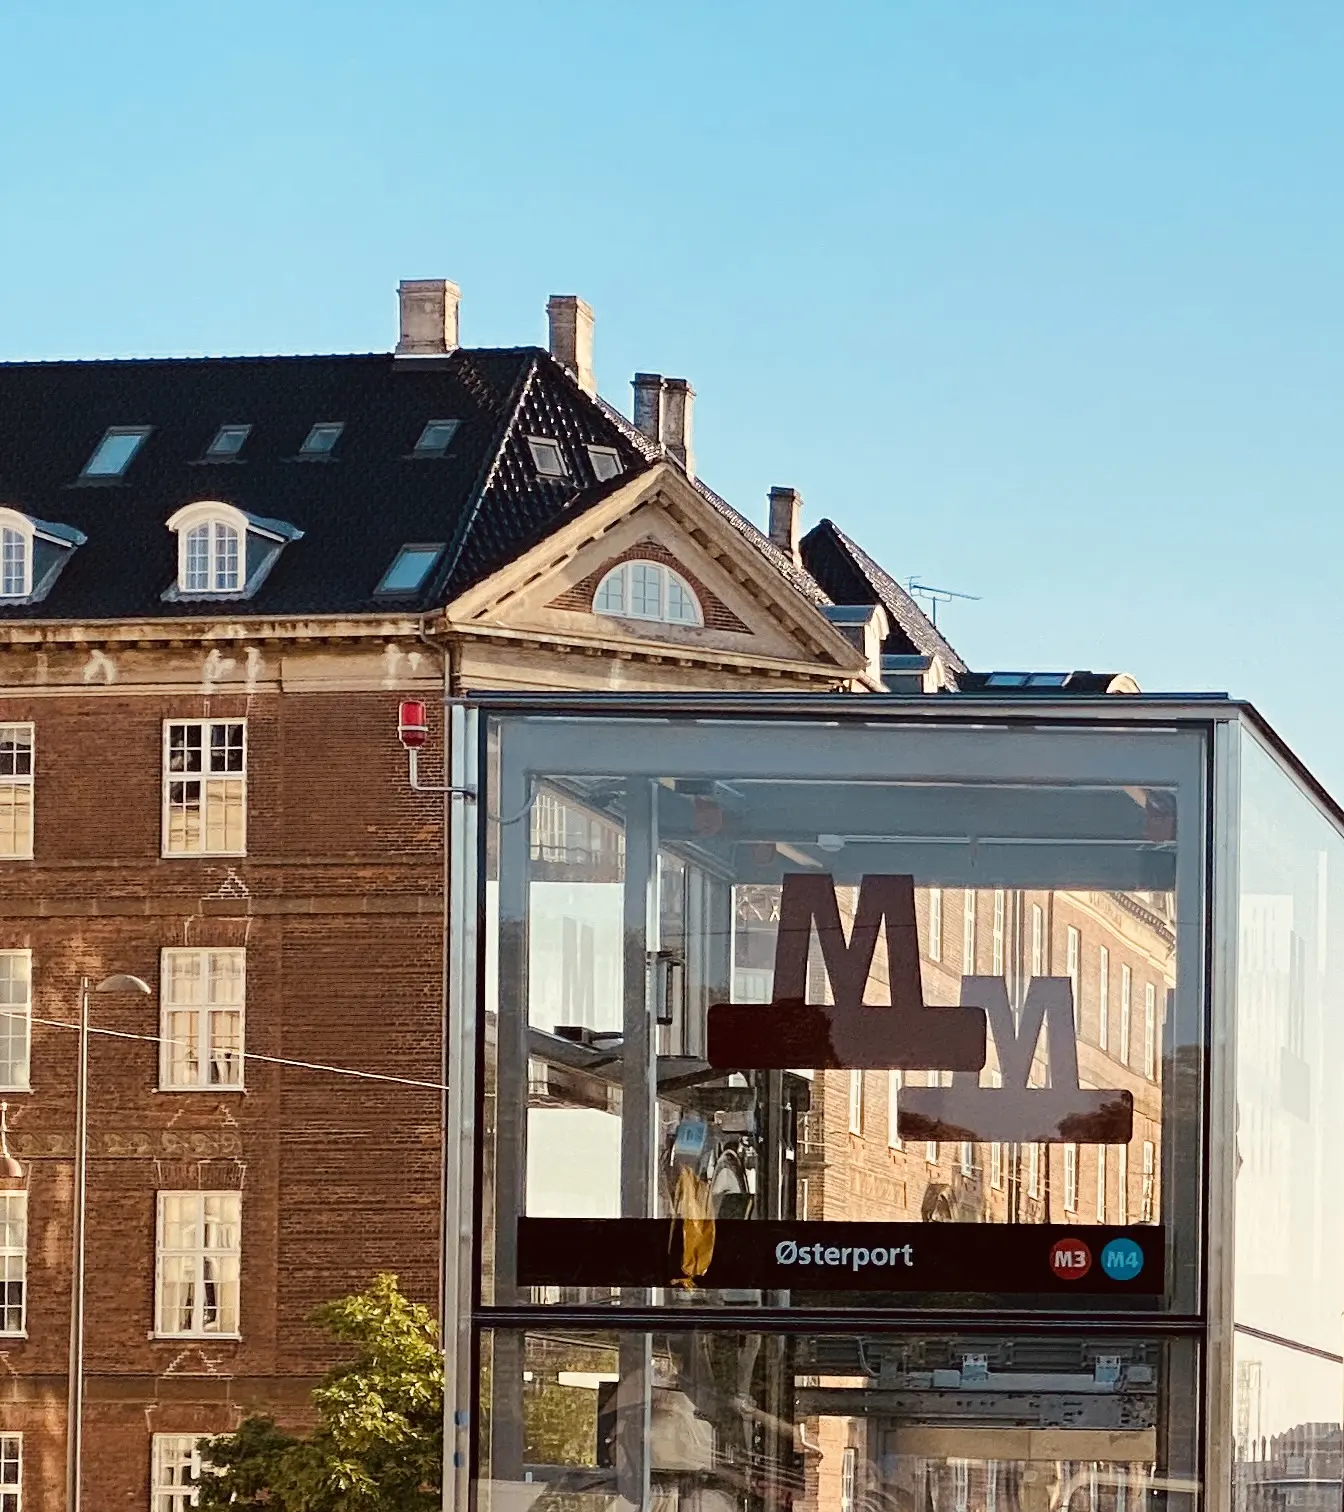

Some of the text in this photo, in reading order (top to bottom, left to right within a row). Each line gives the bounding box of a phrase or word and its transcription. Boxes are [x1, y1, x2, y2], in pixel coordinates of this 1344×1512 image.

[773, 873, 924, 1007] M
[775, 1240, 914, 1272] Østerport
[1054, 1250, 1139, 1268] M3 M4
